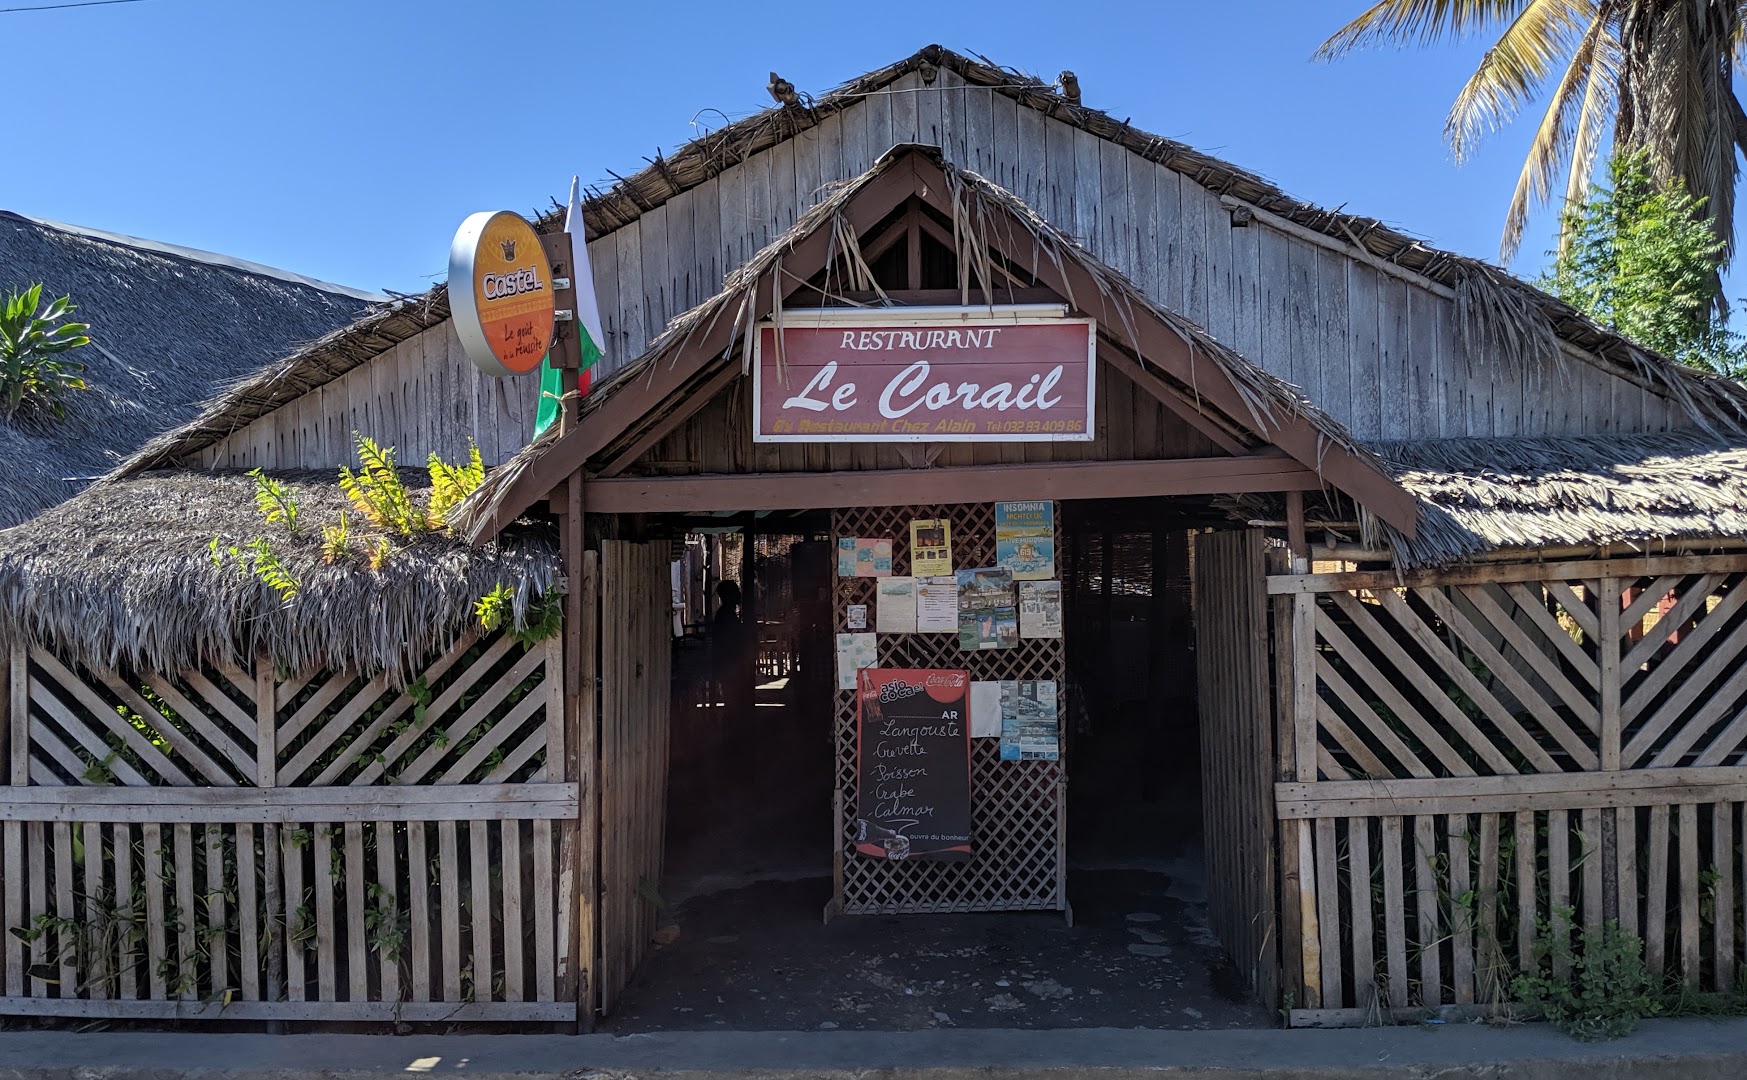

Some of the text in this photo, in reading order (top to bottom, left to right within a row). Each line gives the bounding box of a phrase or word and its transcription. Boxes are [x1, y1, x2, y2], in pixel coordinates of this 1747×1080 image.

[482, 264, 544, 302] Castel
[504, 323, 515, 342] Le
[840, 328, 1001, 350] RESTAURANT
[515, 336, 543, 357] réussite
[782, 360, 1064, 419] Le Corail
[797, 418, 888, 433] Restaurant
[891, 419, 929, 433] Chez
[934, 418, 976, 433] Alain
[1026, 420, 1040, 432] 83
[1042, 420, 1065, 432] 409
[1066, 420, 1082, 432] 86
[1003, 503, 1045, 512] INSOMNIA
[1020, 548, 1031, 556] 619
[941, 710, 958, 720] AR
[879, 719, 961, 744] Langouste
